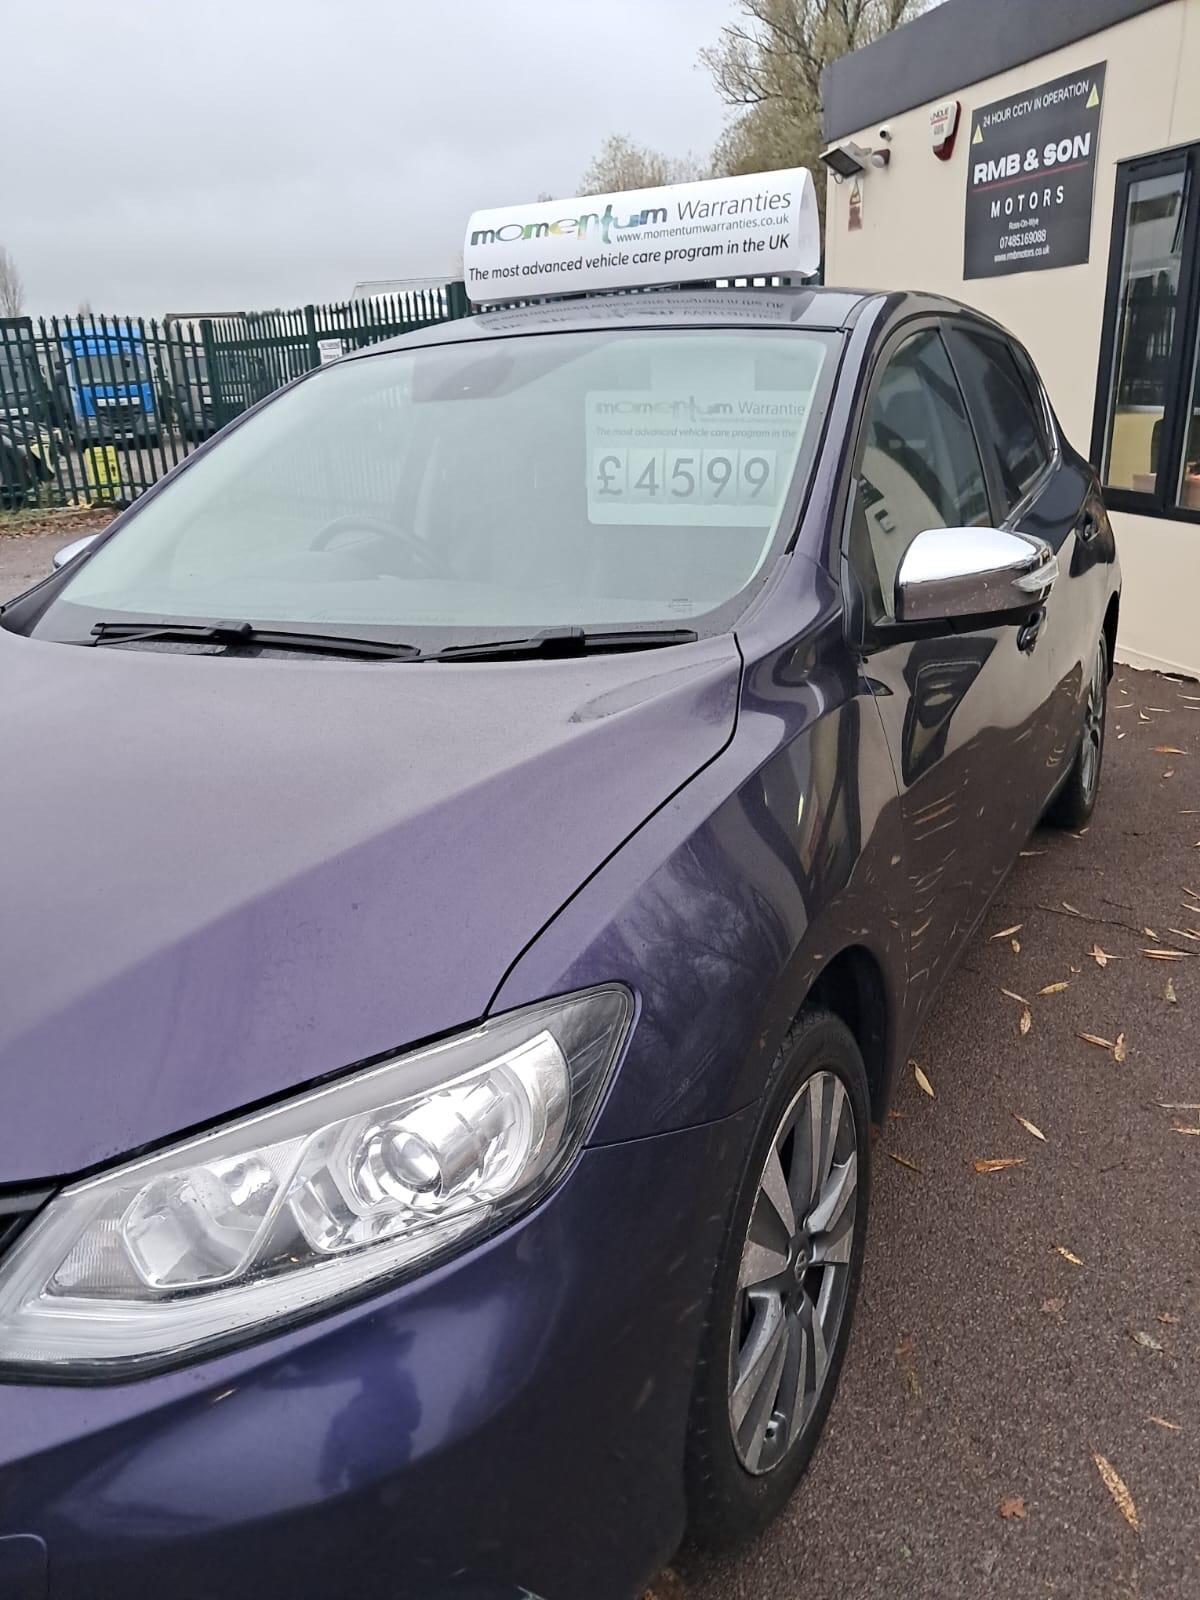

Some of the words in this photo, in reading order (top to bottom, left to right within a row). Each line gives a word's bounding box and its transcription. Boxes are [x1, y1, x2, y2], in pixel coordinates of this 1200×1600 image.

[982, 114, 991, 128] 24
[991, 107, 1012, 125] HOUR
[1012, 100, 1033, 118] CCTV
[1033, 96, 1042, 111] IN
[1042, 80, 1090, 108] OPERATION
[973, 153, 1021, 185] RMB
[1023, 148, 1039, 171] &
[1043, 132, 1091, 166] SON
[470, 204, 668, 246] momentum
[677, 190, 792, 221] Warranties
[990, 185, 1064, 218] MOTORS
[616, 213, 790, 243] www.momentumwarranties.co.uk
[999, 228, 1047, 250] 07485169088
[468, 267, 489, 281] The
[491, 265, 520, 279] most
[521, 256, 582, 276] advanced
[585, 252, 630, 268] vehicle
[632, 250, 662, 264] care
[664, 243, 724, 264] program
[727, 239, 740, 254] in
[743, 237, 766, 252] the
[769, 233, 791, 250] UK
[738, 401, 806, 416] Warrantie
[596, 455, 770, 498] £4599
